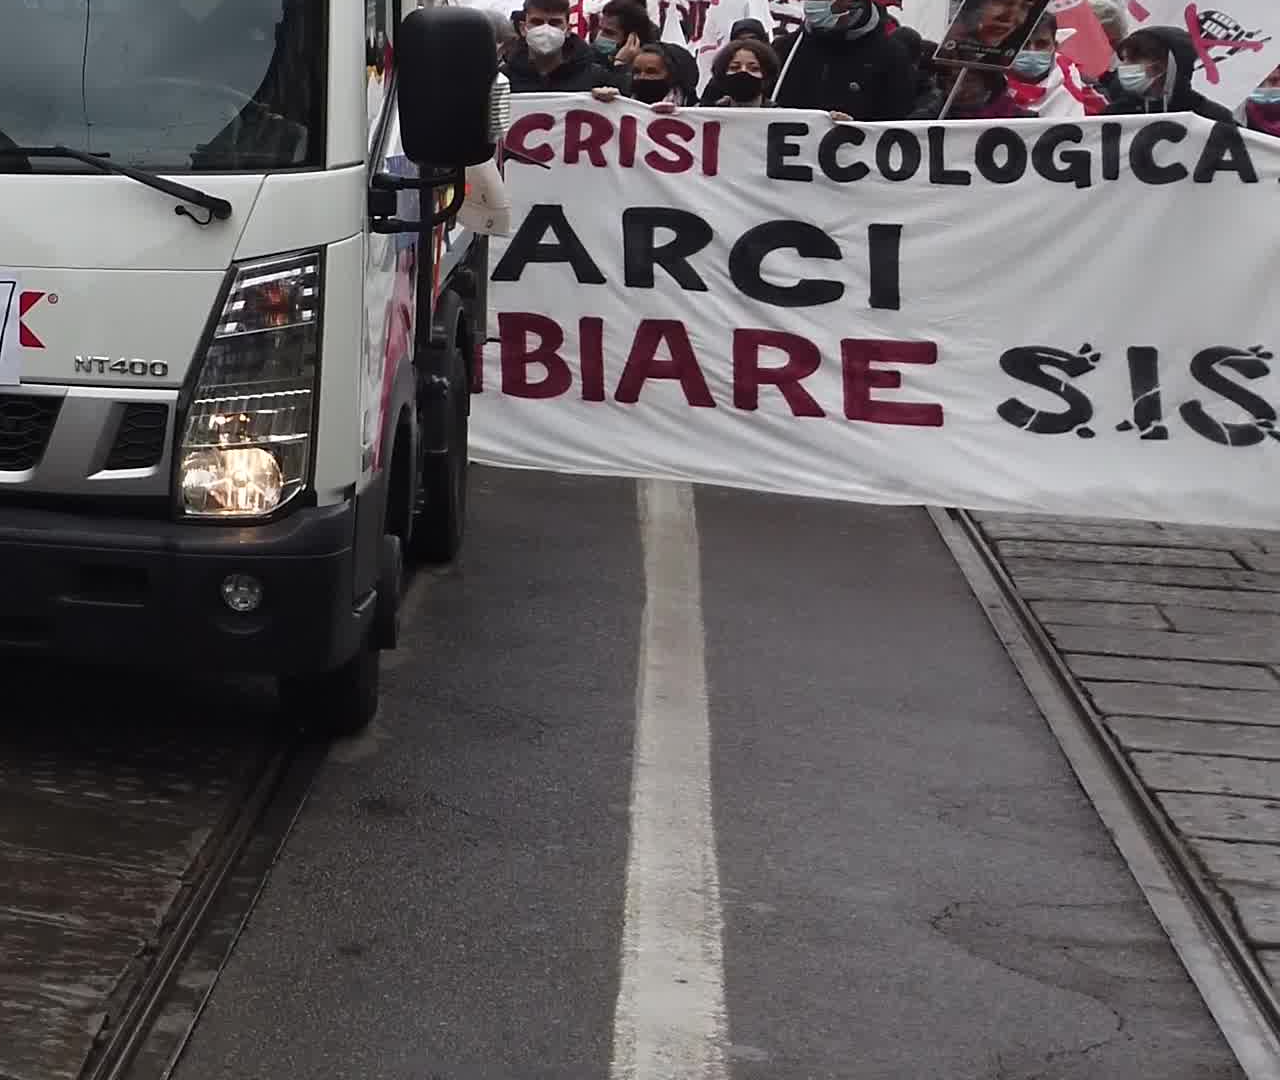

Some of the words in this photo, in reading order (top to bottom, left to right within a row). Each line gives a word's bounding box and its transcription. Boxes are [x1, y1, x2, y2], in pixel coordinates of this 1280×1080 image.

[504, 109, 721, 178] CRISI
[765, 119, 1259, 190] ECOLOGICA
[73, 354, 169, 378] NT400
[470, 311, 945, 428] BIARE
